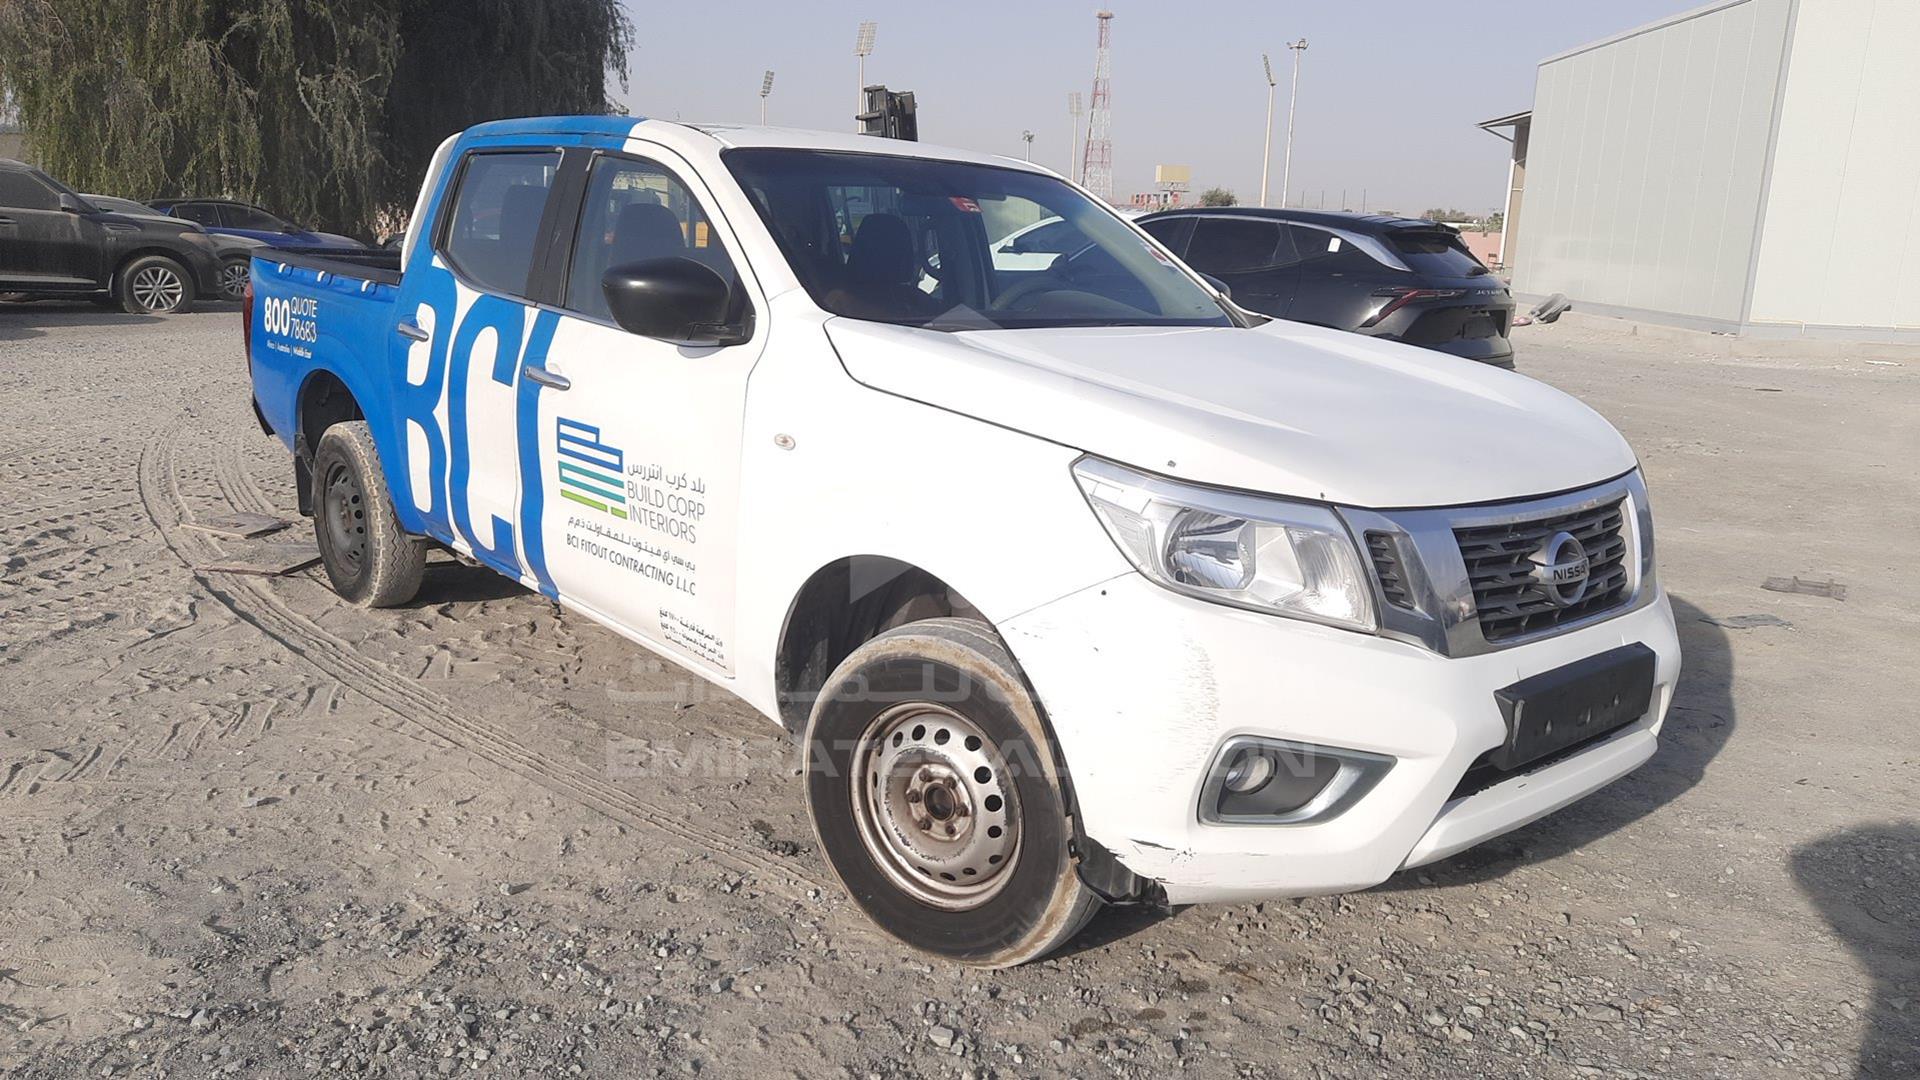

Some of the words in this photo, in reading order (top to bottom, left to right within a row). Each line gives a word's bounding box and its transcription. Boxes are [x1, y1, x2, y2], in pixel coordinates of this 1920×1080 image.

[264, 296, 290, 337] 800
[290, 296, 318, 318] QUOTE
[290, 318, 317, 343] 78683
[627, 480, 665, 509] BUILD
[667, 493, 706, 522] CORP
[629, 503, 697, 545] INTERIORS
[566, 533, 579, 549] BCI
[580, 538, 608, 560] FITOUT
[608, 550, 675, 586] CONTRACTING
[675, 576, 697, 597] L.L.C
[1553, 560, 1588, 580] NISSA
